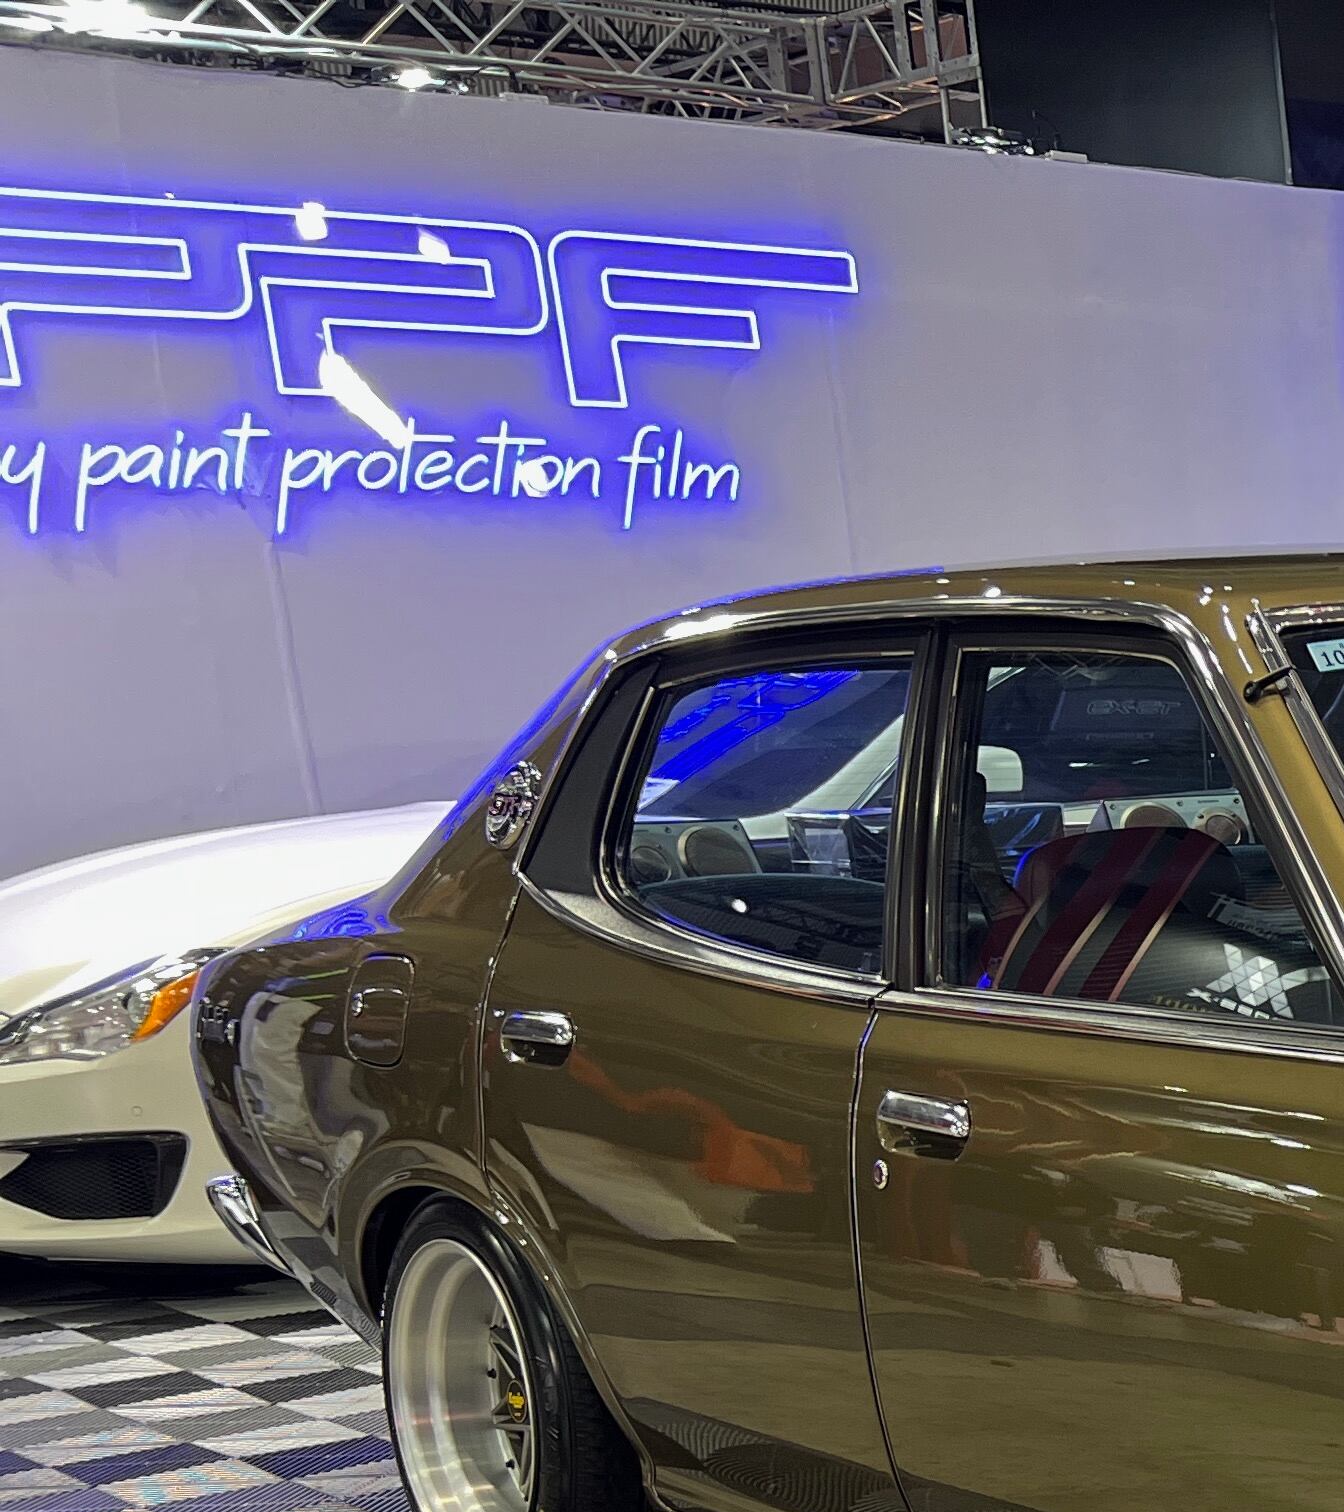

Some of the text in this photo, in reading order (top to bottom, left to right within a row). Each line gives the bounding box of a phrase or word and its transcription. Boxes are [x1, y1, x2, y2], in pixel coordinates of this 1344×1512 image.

[75, 412, 271, 533] paint
[276, 416, 602, 535] protection
[617, 424, 741, 530] film
